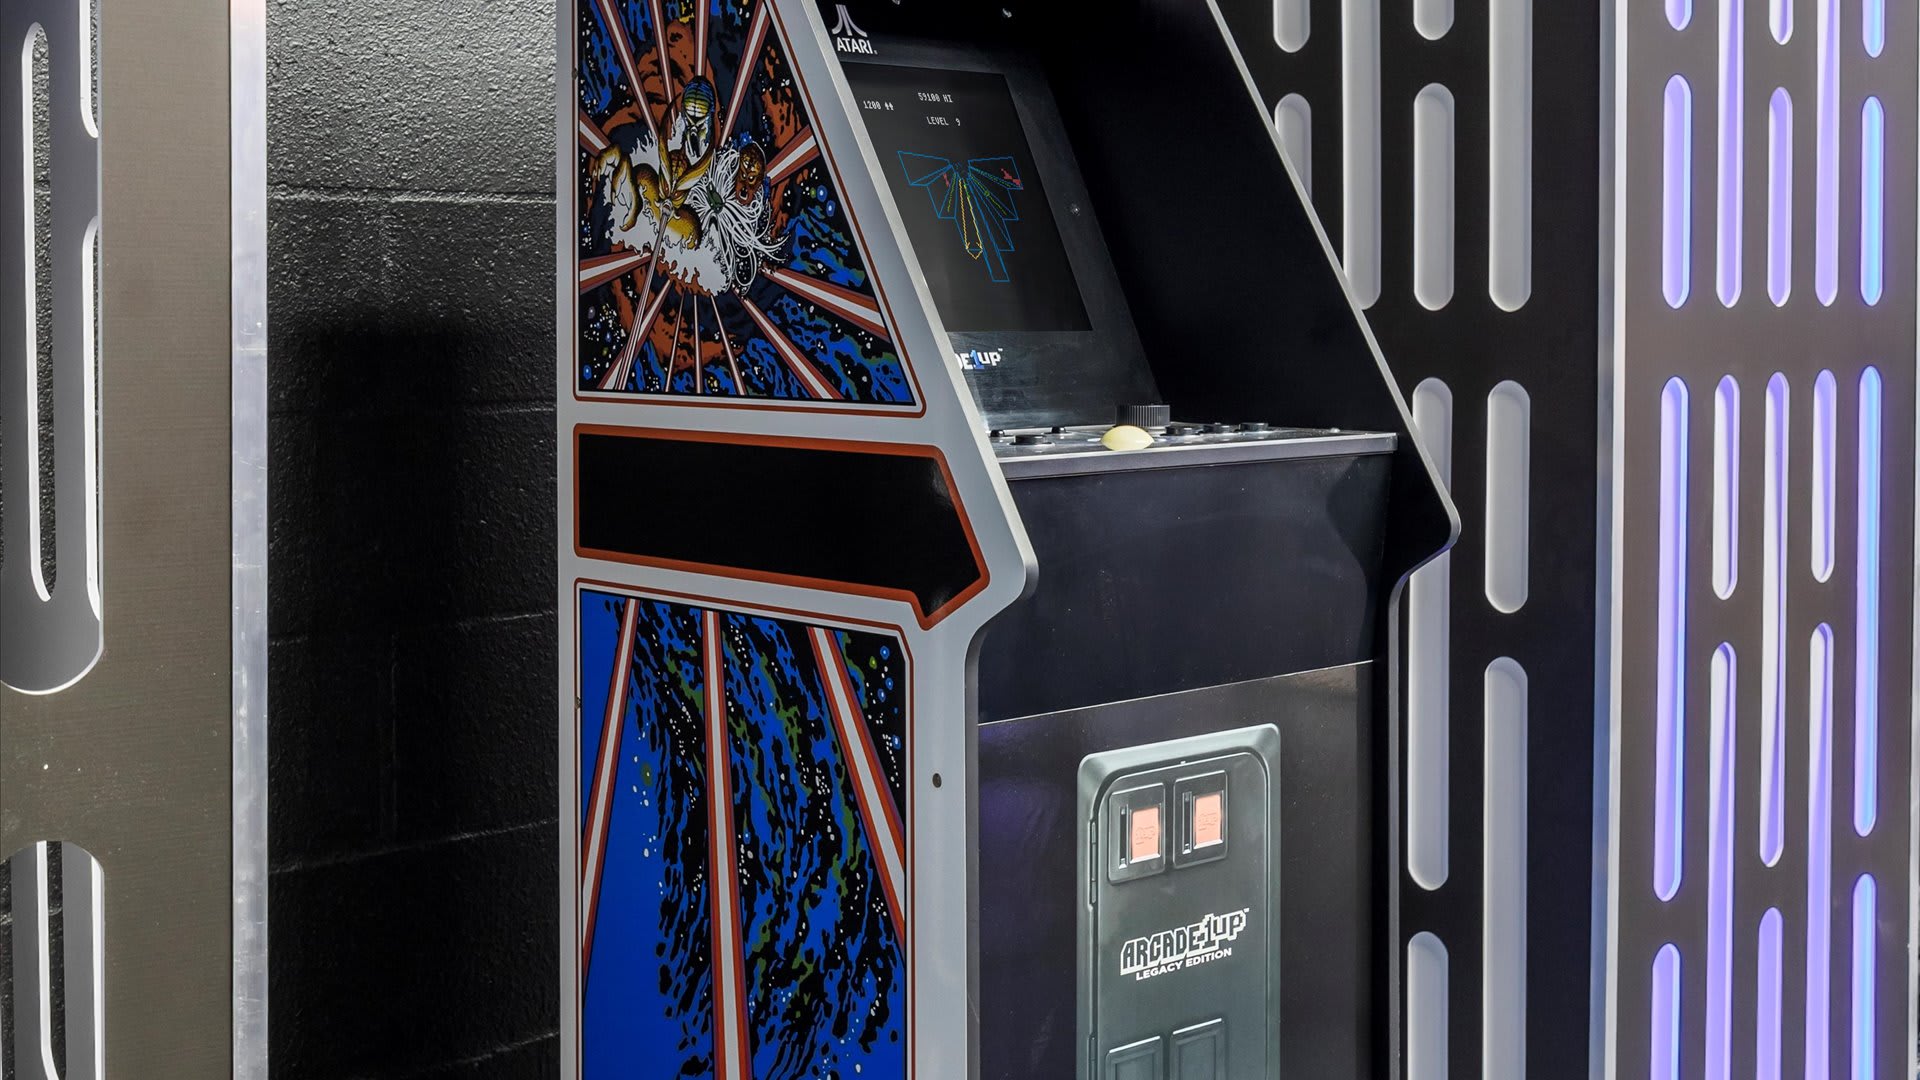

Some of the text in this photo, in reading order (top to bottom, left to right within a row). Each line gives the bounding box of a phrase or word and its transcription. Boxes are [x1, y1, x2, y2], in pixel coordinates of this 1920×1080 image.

[836, 36, 873, 54] ATARI
[918, 92, 953, 103] 59100 HI
[863, 100, 881, 110] 1200
[926, 116, 961, 127] LEVEL 9
[1136, 947, 1232, 981] LEGACY EDITION
